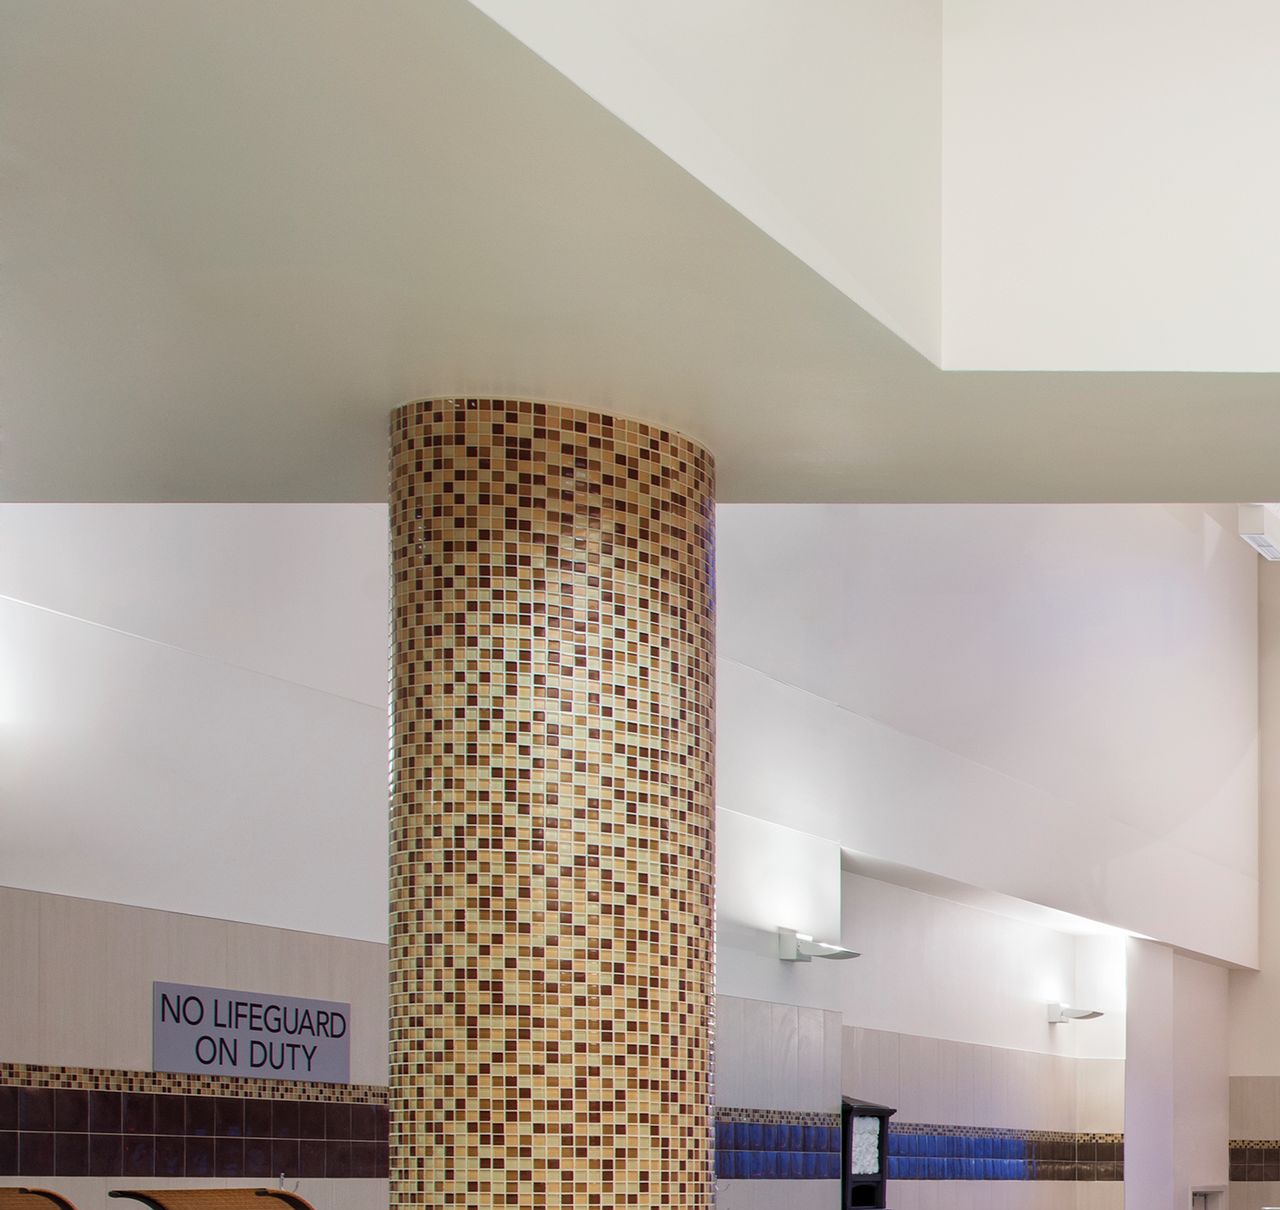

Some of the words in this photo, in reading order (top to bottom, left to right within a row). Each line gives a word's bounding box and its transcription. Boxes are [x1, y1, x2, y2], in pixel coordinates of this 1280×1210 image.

[161, 993, 204, 1026] NO
[213, 999, 346, 1039] LIFEGUARD
[195, 1035, 237, 1066] ON
[250, 1040, 318, 1071] DUTY
